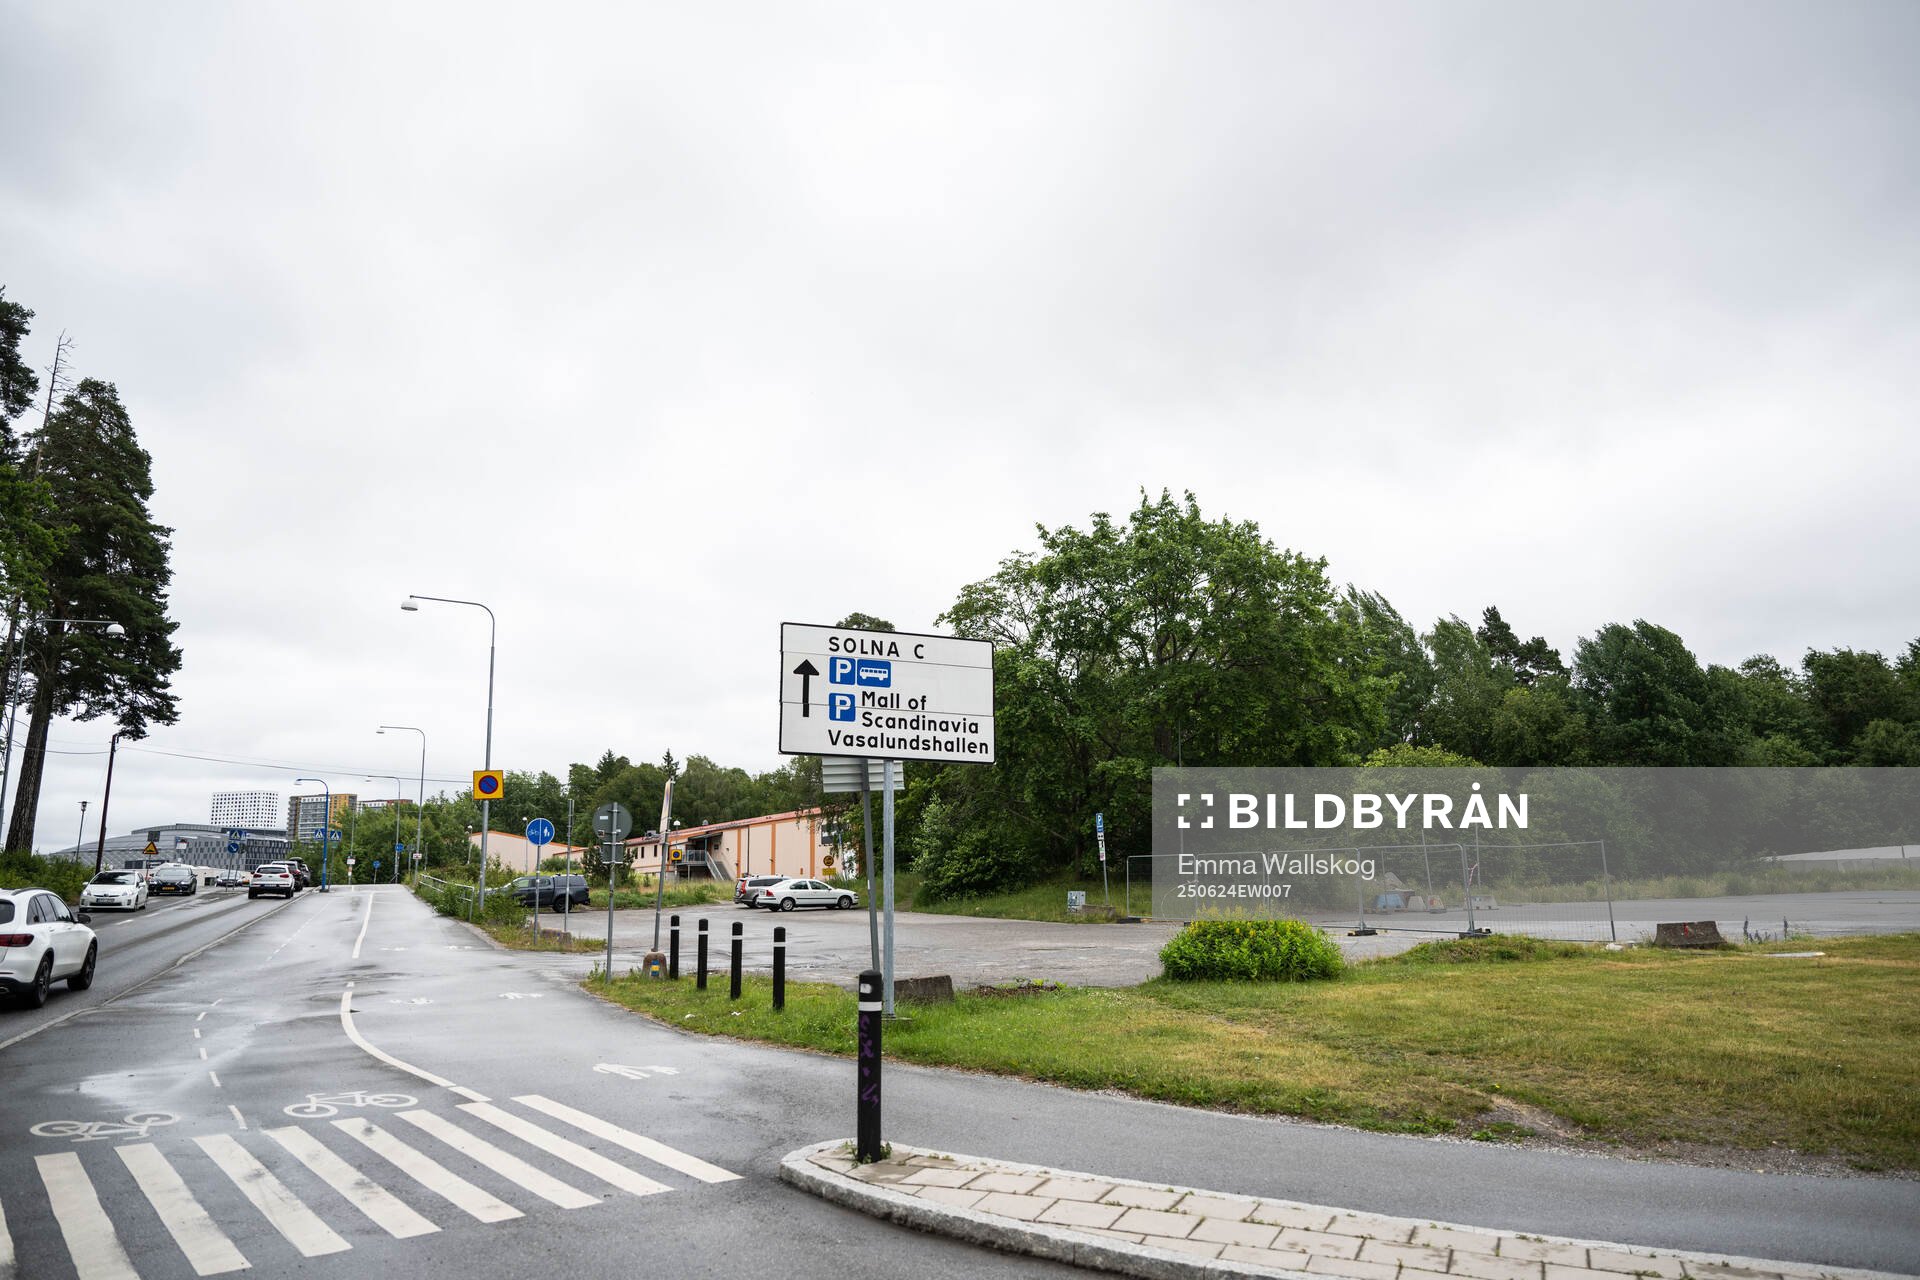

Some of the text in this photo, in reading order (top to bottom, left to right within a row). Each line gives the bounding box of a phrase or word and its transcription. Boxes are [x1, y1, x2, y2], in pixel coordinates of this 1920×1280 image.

[828, 636, 925, 659] SOLNA C
[836, 659, 852, 682] P
[835, 695, 852, 719] P
[861, 691, 926, 711] Mall of
[862, 712, 979, 734] Scandinavia
[828, 729, 989, 754] Vasalundshallen
